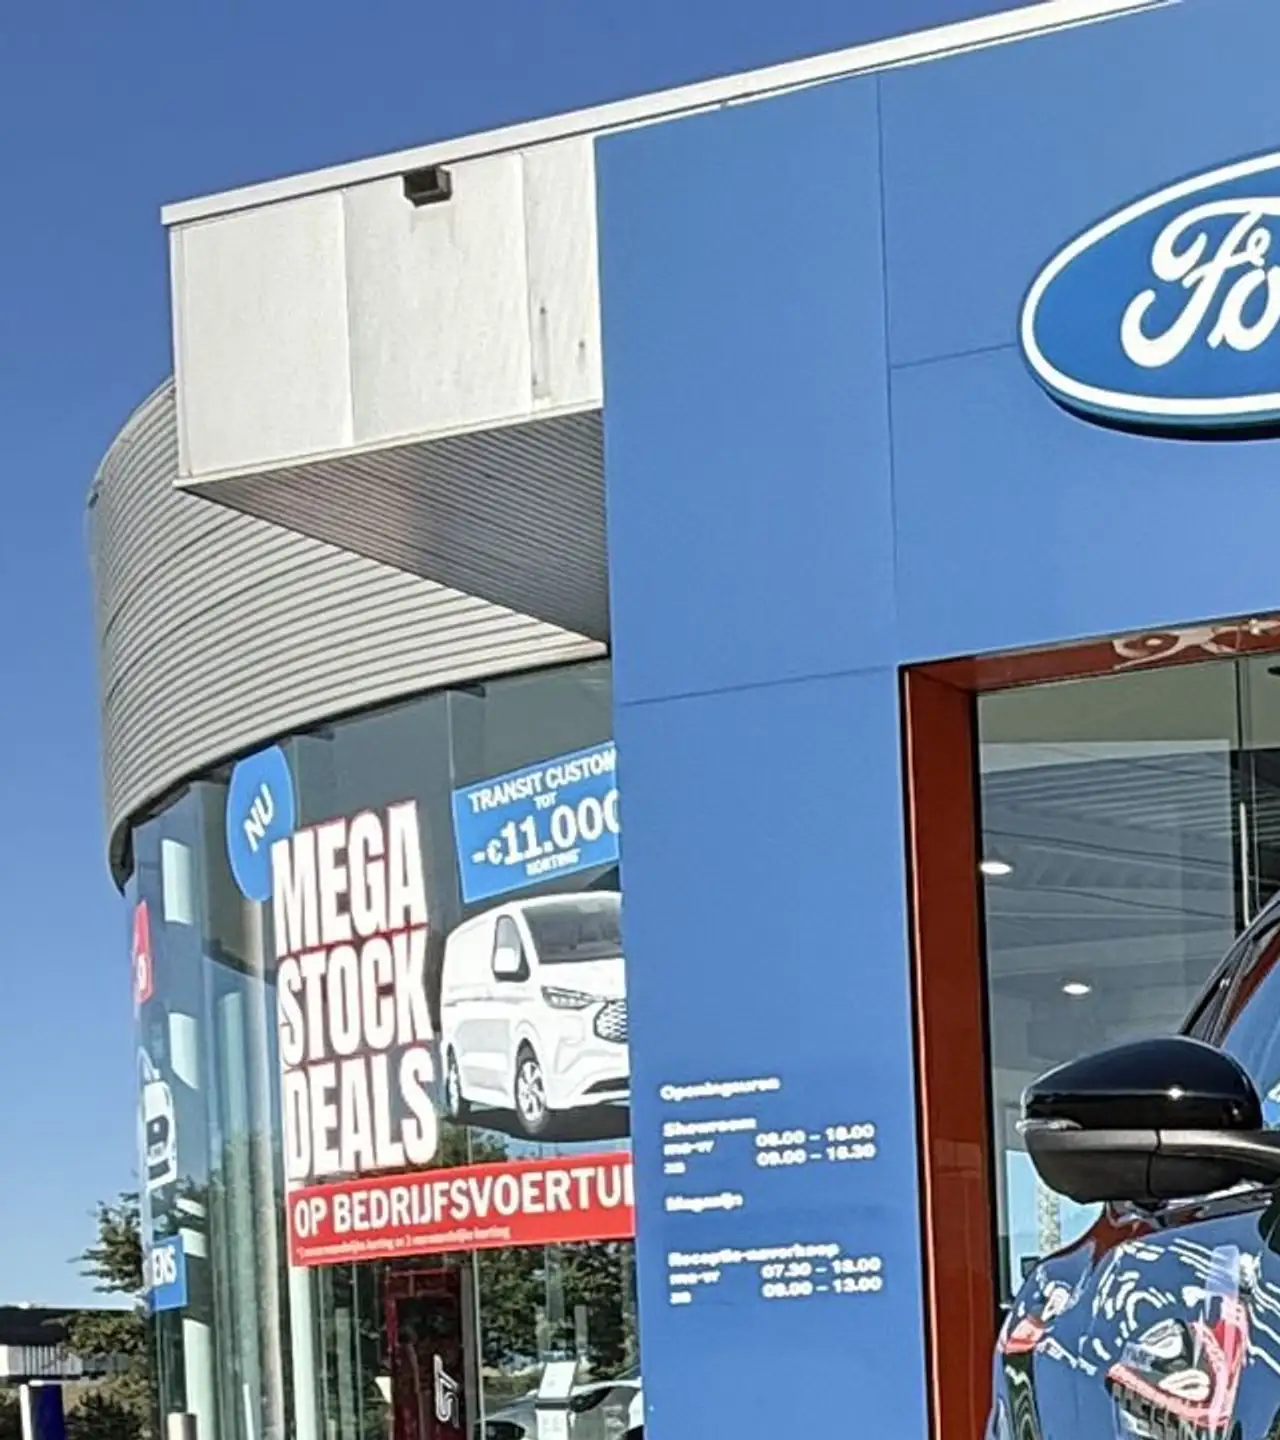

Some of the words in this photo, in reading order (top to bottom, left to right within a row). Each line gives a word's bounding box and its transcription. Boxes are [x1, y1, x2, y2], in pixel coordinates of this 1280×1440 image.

[468, 772, 544, 813] TRANSIT
[545, 747, 617, 790] CUSTOM
[532, 791, 557, 811] TOT
[243, 783, 275, 853] NU
[271, 800, 429, 959] MEGA
[277, 929, 434, 1067] STOCK
[283, 1046, 438, 1182] DEALS
[294, 1196, 327, 1239] OP
